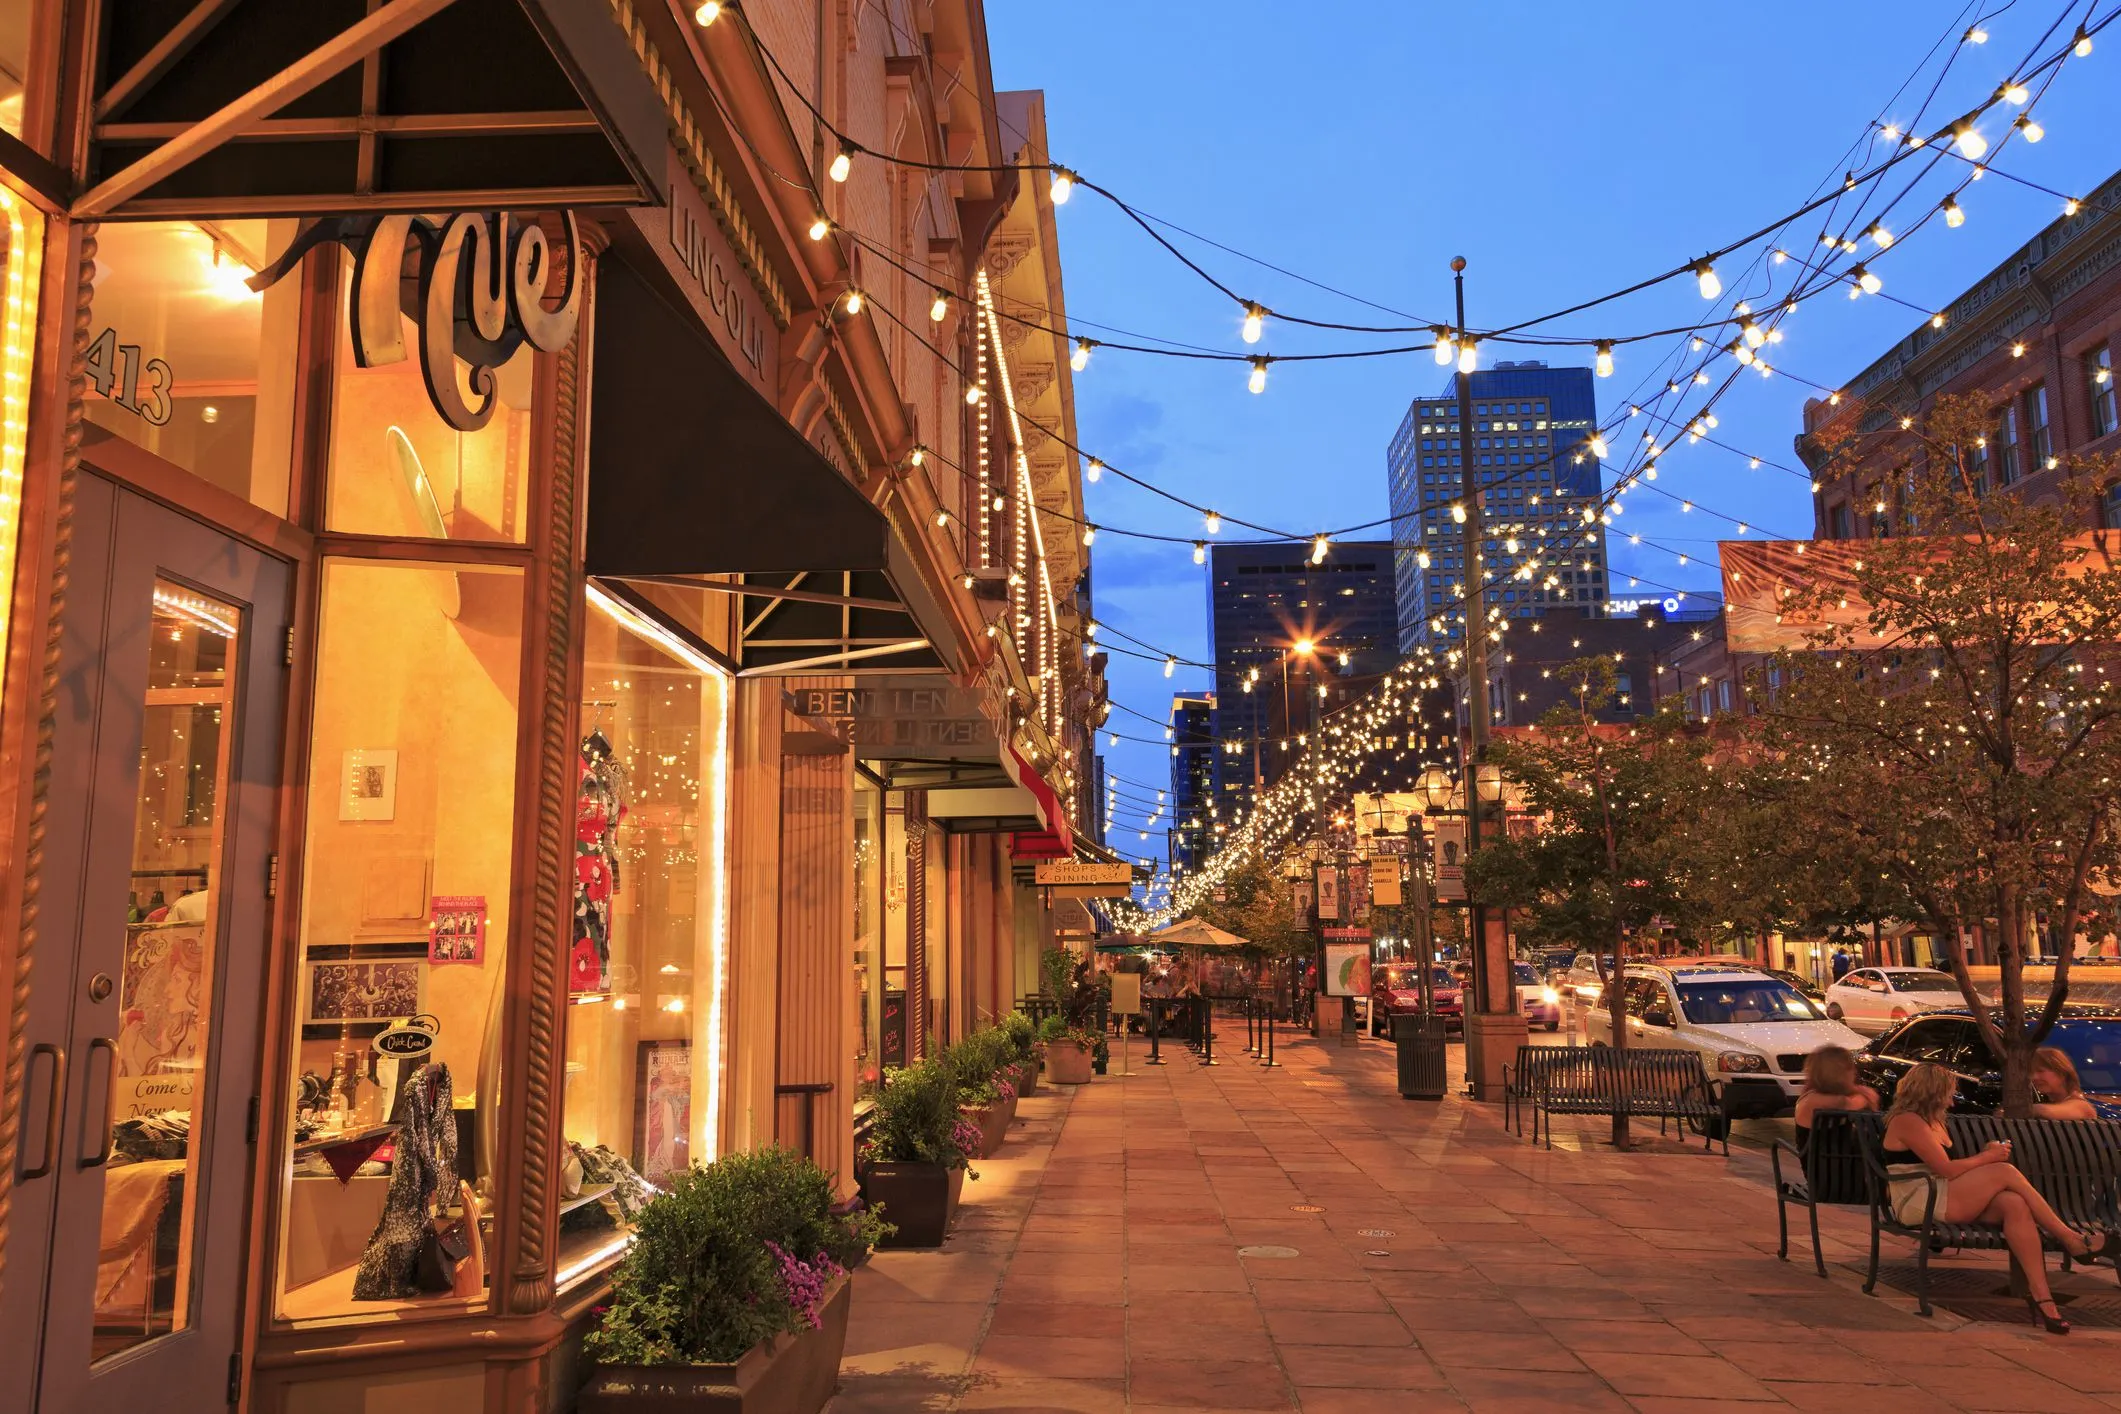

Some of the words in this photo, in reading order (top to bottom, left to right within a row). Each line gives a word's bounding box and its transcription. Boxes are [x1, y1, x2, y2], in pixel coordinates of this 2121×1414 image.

[669, 183, 765, 382] LINCOLN
[84, 327, 173, 426] 413
[808, 690, 884, 715] BENT
[895, 690, 953, 715] LEN
[1054, 874, 1098, 882] DINING
[1055, 865, 1097, 873] SHOPS
[135, 1079, 177, 1098] Come
